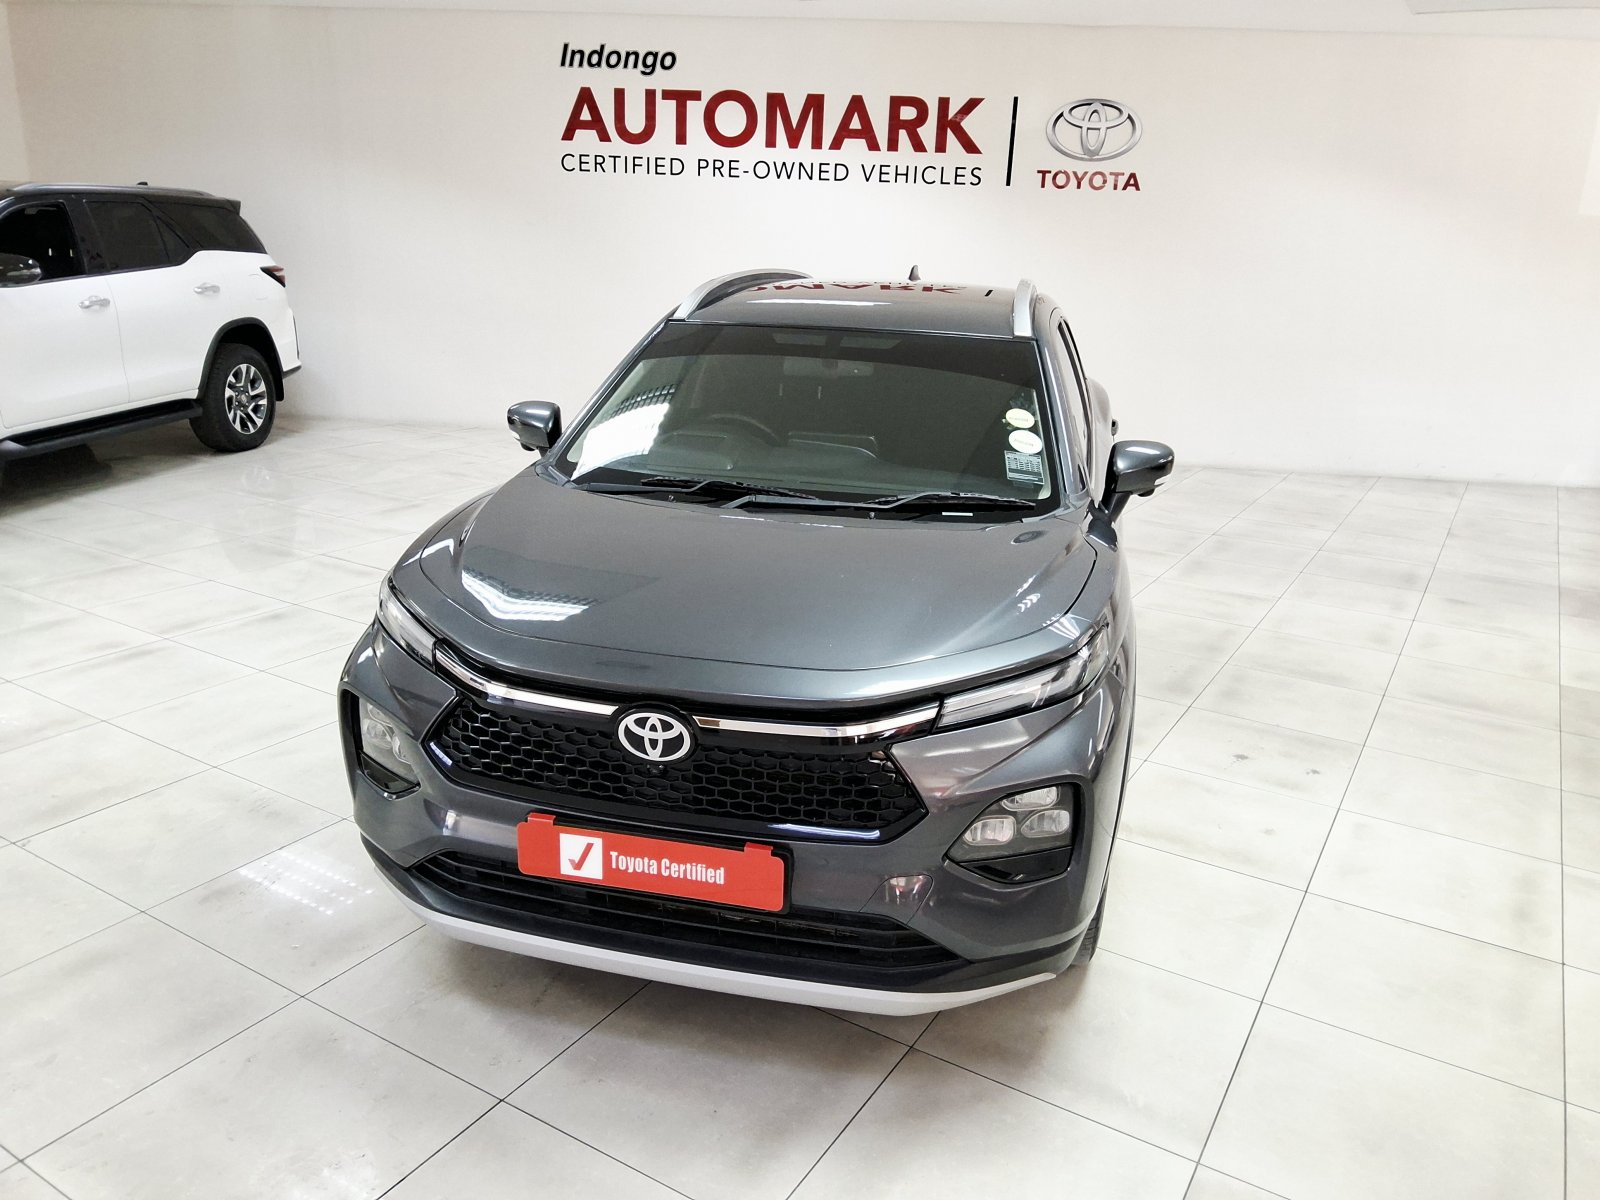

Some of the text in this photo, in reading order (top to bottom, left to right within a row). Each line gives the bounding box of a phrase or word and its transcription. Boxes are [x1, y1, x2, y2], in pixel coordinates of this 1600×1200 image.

[560, 43, 677, 75] Indongo
[561, 87, 985, 155] AUTOMARK
[560, 154, 982, 187] CERTIFIED PRE-OWNED VEHICLES
[1037, 169, 1141, 191] TOYOTA
[610, 851, 725, 885] Toyota Certified
